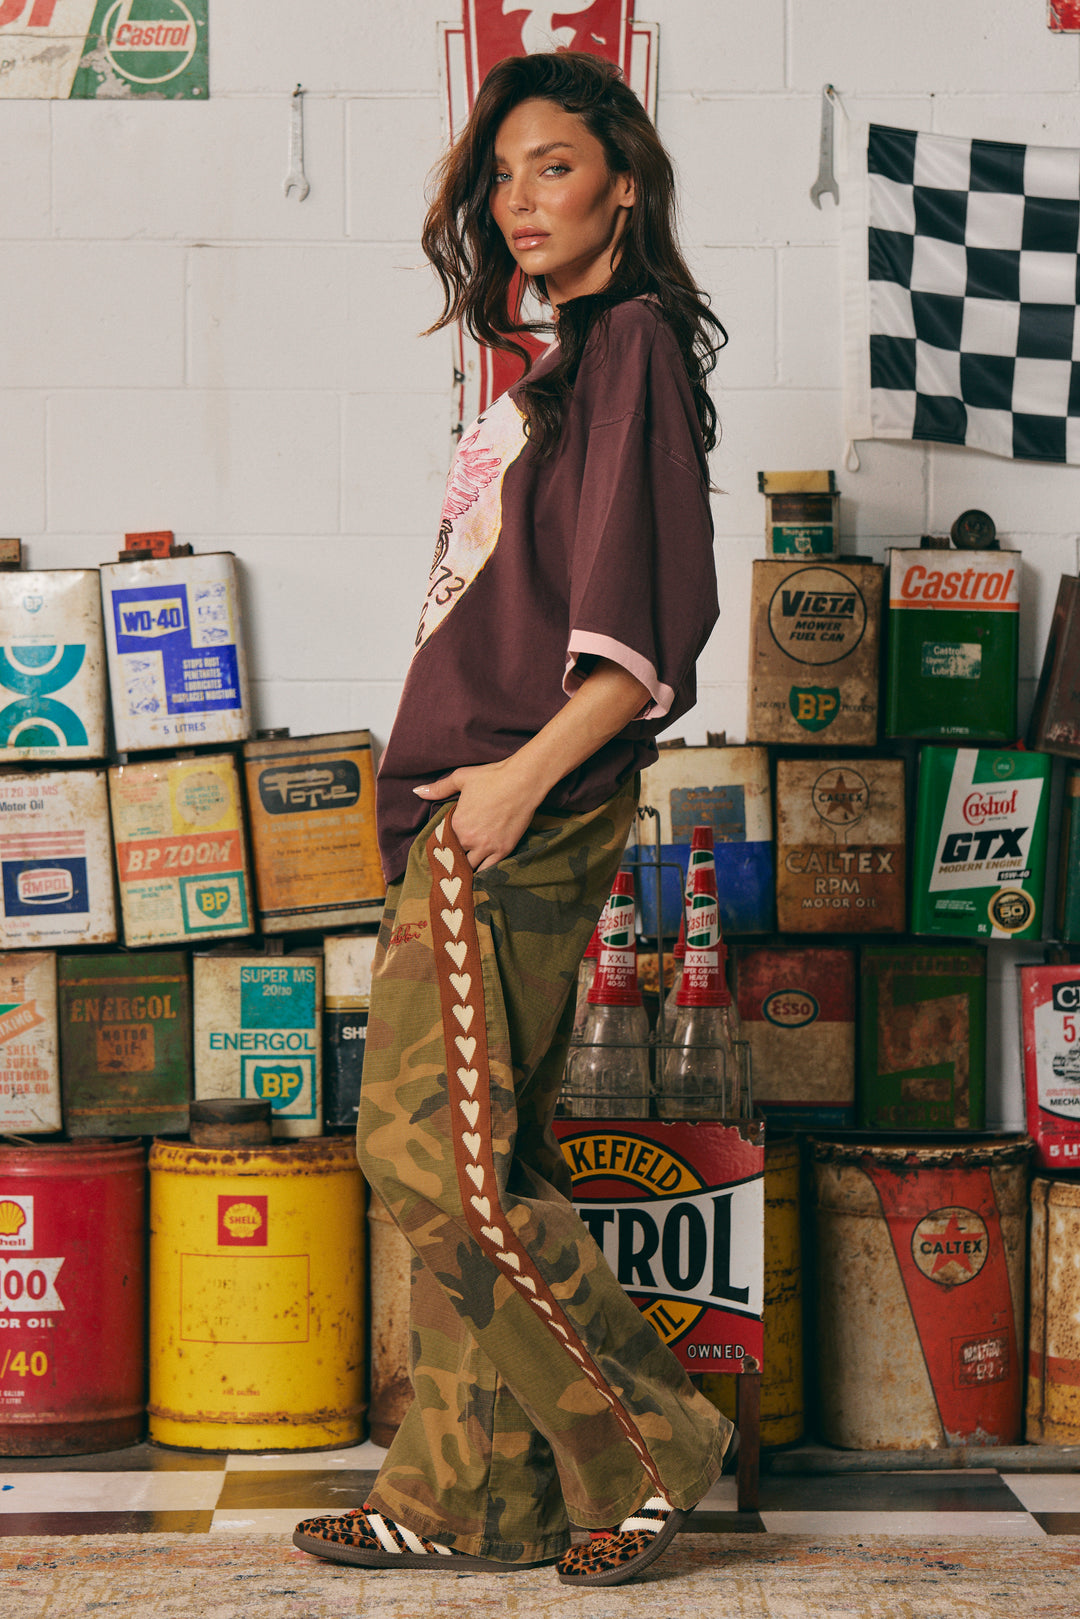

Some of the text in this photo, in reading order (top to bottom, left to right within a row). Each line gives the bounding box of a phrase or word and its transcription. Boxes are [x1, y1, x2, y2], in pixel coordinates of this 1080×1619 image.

[117, 23, 193, 47] Castrol
[901, 565, 1015, 601] Castrol
[795, 621, 842, 632] MOWER
[789, 632, 845, 643] FUEL CAN
[796, 693, 837, 721] BP
[163, 722, 207, 735] 5 LITRES
[947, 726, 970, 735] LITRES
[0, 799, 44, 812] Motor Oil
[817, 793, 864, 804] CALTEX
[962, 789, 1019, 827] Castrol
[940, 827, 1029, 863] GTX
[126, 839, 236, 874] BP ZOOM
[785, 851, 895, 874] CALTEX
[938, 858, 1025, 878] MODERN ENGINE
[999, 870, 1031, 881] 15W-40
[22, 879, 70, 898] AMPOL
[814, 878, 860, 896] RPM
[202, 892, 229, 912] BP
[801, 898, 877, 910] MOTOR OIL
[607, 953, 629, 964] XXL
[689, 954, 711, 964] XXL
[241, 968, 316, 983] SUPER MS
[606, 974, 628, 982] HEAVY
[689, 974, 709, 982] HEAVY
[698, 967, 719, 975] GRADE
[689, 981, 709, 989] 40-50
[1056, 984, 1080, 1009] C
[70, 995, 177, 1023] ENERGOL
[102, 1027, 149, 1041] MOTOR
[208, 1032, 317, 1051] ENERGOL
[7, 1045, 37, 1056] SHELL
[6, 1057, 39, 1069] SUPER
[34, 1083, 51, 1095] OIL
[260, 1072, 300, 1098] BP
[1048, 1144, 1061, 1158] 5
[568, 1138, 683, 1192] KEFIELD
[228, 1214, 258, 1225] SHELL
[919, 1240, 983, 1255] CALTEX
[27, 1317, 56, 1328] OIL
[686, 1344, 746, 1360] OWNED
